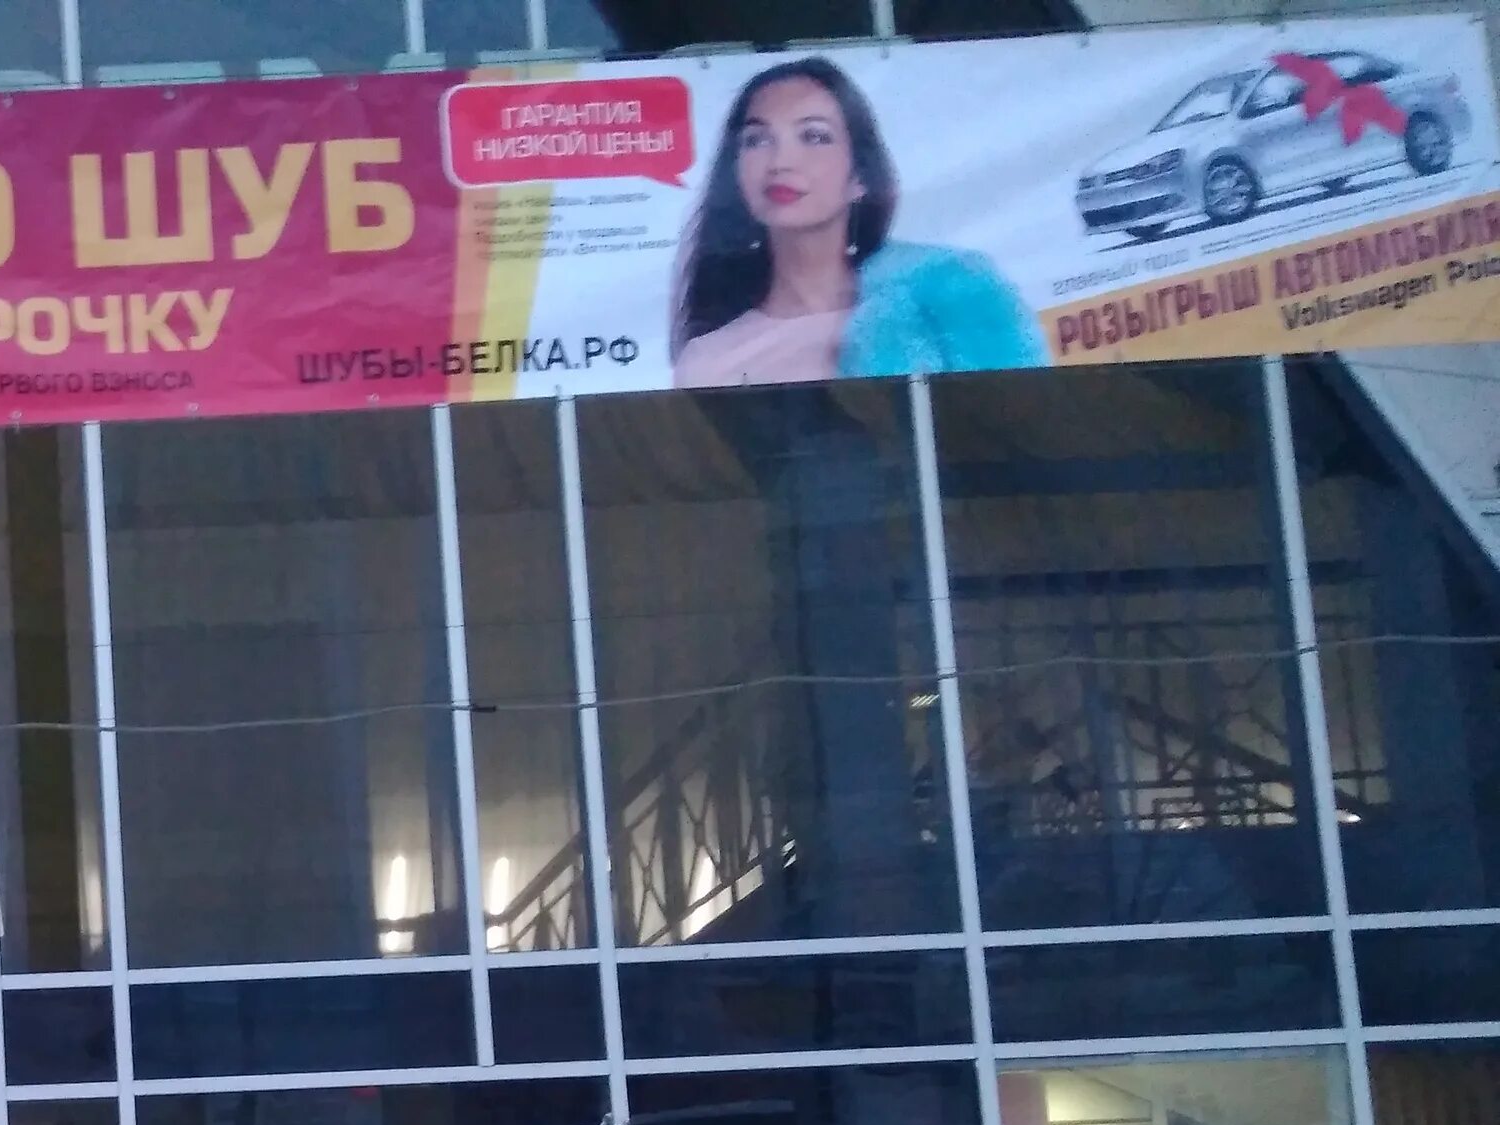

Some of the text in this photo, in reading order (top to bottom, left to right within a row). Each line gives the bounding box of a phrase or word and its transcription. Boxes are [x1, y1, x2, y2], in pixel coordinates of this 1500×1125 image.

[502, 100, 642, 130] ГАРАНТИЯ
[474, 129, 675, 162] НИЗКОЙ ЦЕНЫ!
[70, 137, 415, 269] ШУБ
[1056, 265, 1262, 356] РОЗЫГРЫШ
[1281, 274, 1437, 330] Volkswagen
[91, 371, 195, 393] ВЗНОСА
[297, 336, 640, 384] ШУБЫ-БЕЛКА.РФ
